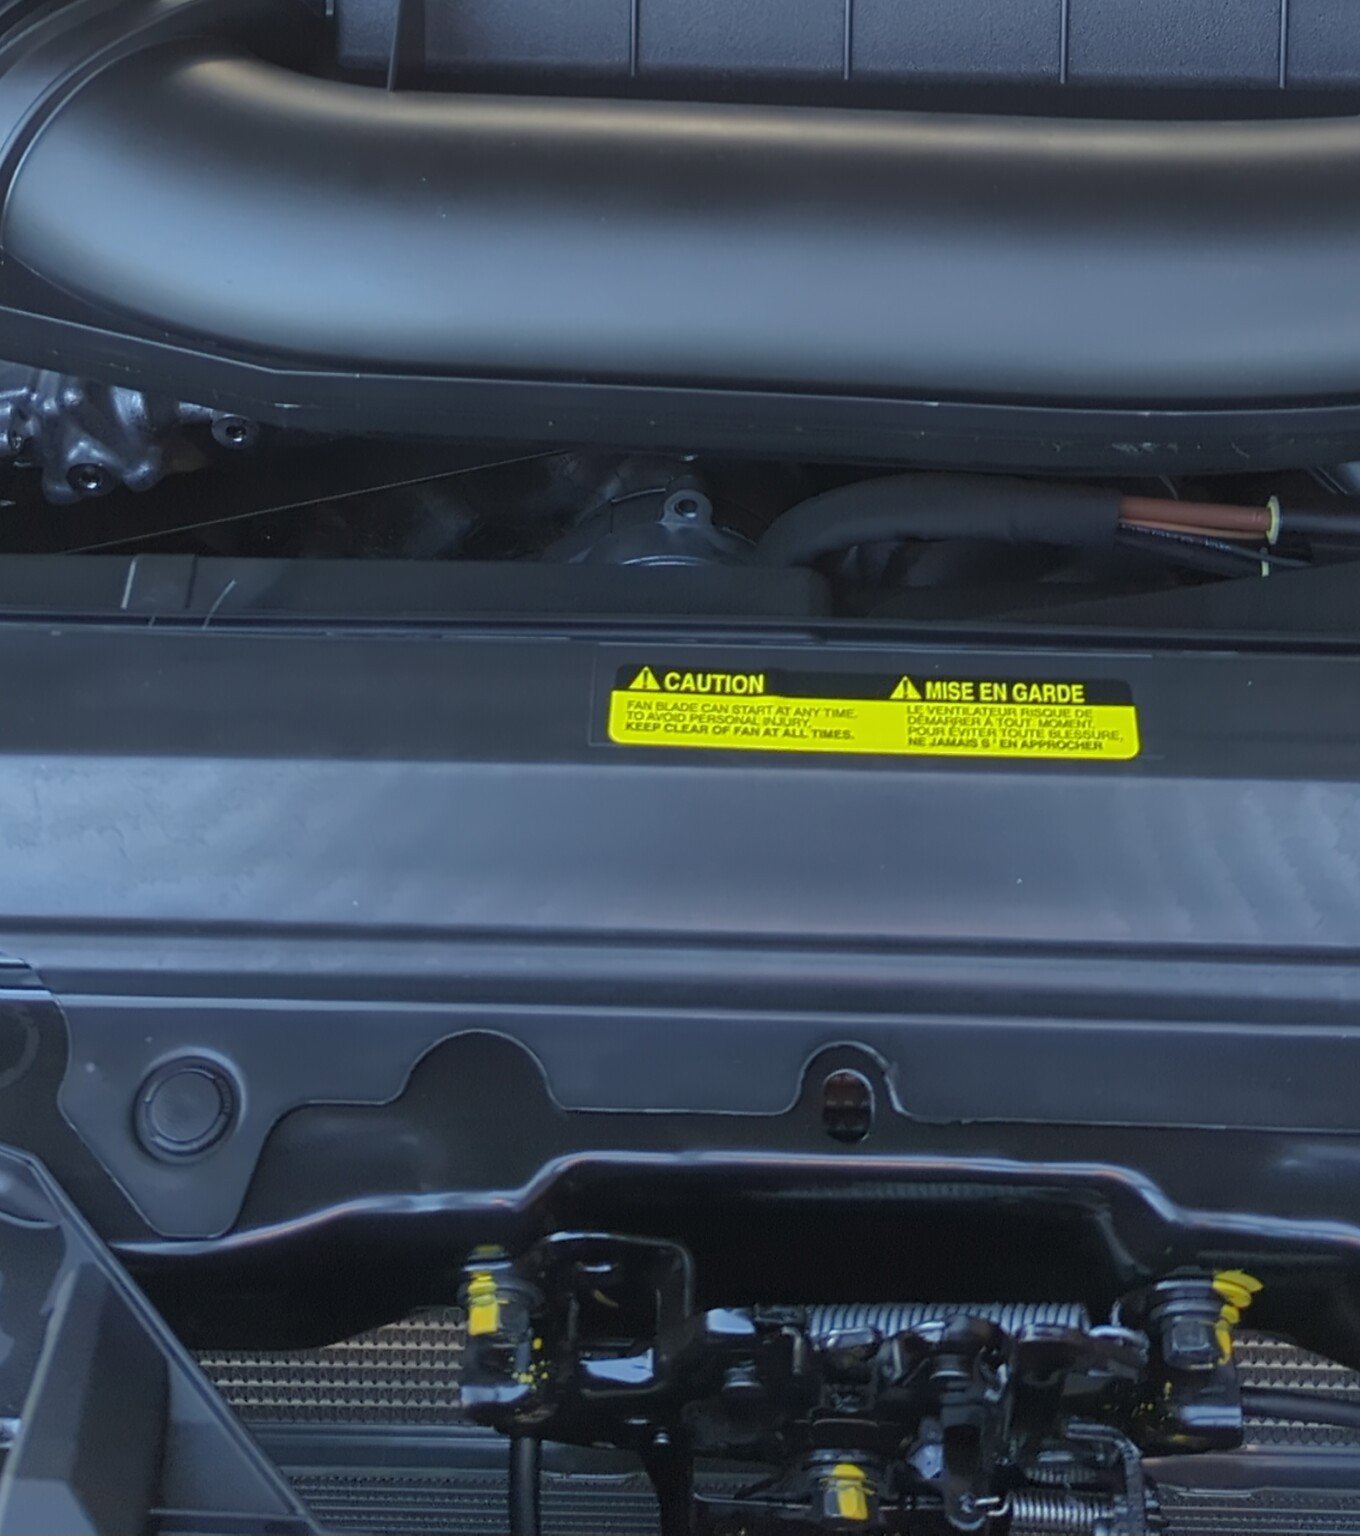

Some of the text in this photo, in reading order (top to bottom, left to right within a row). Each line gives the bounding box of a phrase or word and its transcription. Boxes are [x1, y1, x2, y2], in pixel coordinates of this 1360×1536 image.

[664, 672, 1085, 703] CAUTION MISE EN GARDE
[627, 700, 653, 710] FAN
[656, 701, 698, 712] BLADE
[701, 703, 728, 713] CAN
[734, 704, 773, 715] START
[776, 706, 791, 715] AT
[793, 707, 821, 718] ANY
[907, 705, 1092, 718] LE VENTILATEUR RISQUE DE
[627, 711, 645, 720] TO
[648, 712, 686, 722] AVOID
[690, 713, 758, 725] PERSONAL
[997, 718, 1030, 728] TOUT
[625, 722, 660, 732] KEEP
[663, 723, 708, 734] CLEAR
[714, 725, 729, 735] OF
[734, 726, 760, 736] FAN
[762, 727, 778, 737] AT
[782, 728, 808, 738] ALL
[908, 727, 945, 737] POUR
[1001, 728, 1045, 739] TOUTE
[908, 737, 926, 747] NE
[931, 738, 978, 748] JAMAIS
[1021, 740, 1103, 750] APPROCHER
